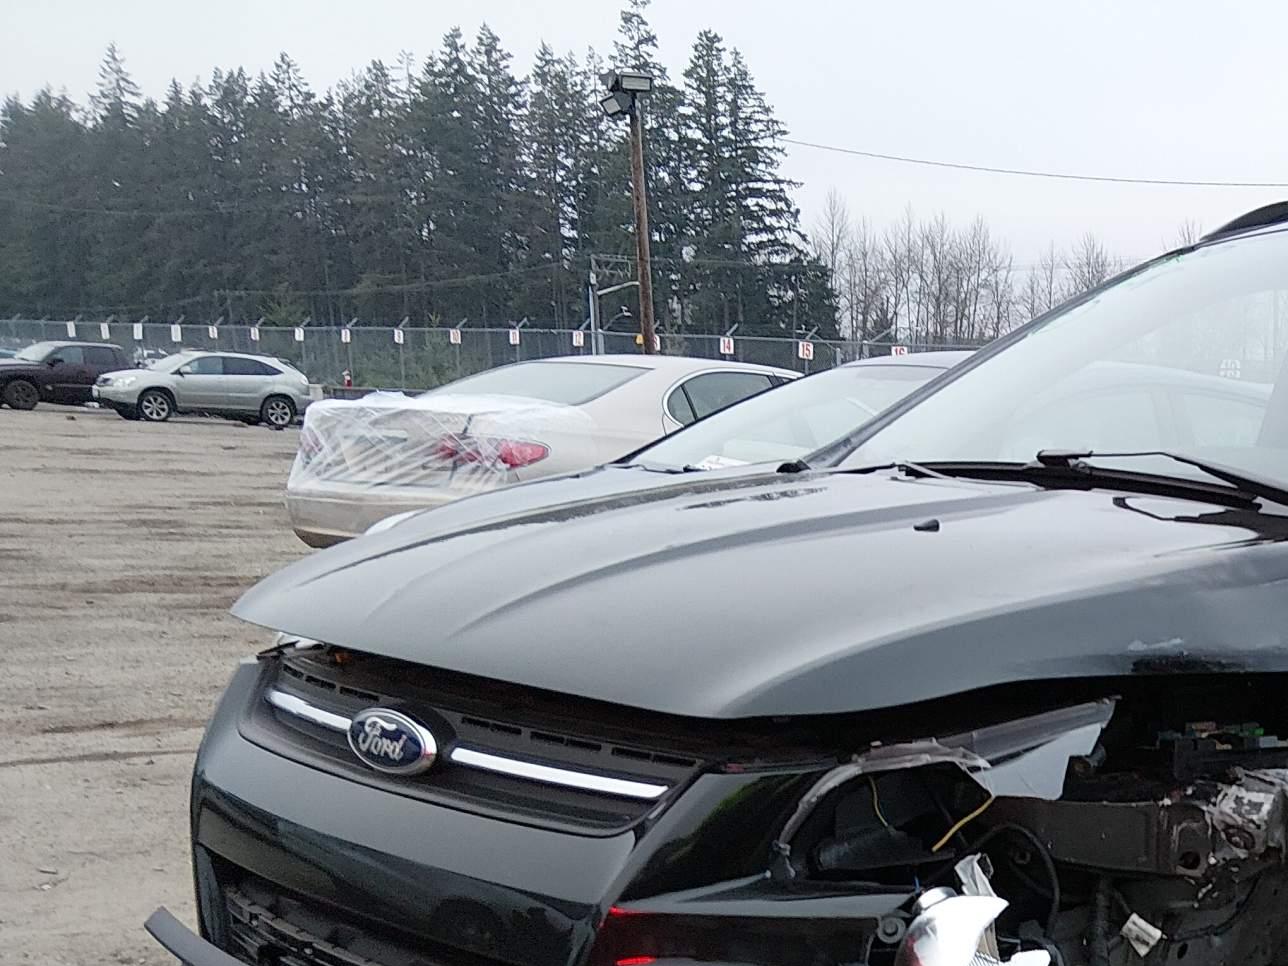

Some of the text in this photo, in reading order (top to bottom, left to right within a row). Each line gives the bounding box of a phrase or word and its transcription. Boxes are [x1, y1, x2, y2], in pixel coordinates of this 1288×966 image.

[722, 338, 731, 352] 14
[801, 343, 811, 357] 15
[358, 716, 407, 761] Ford
